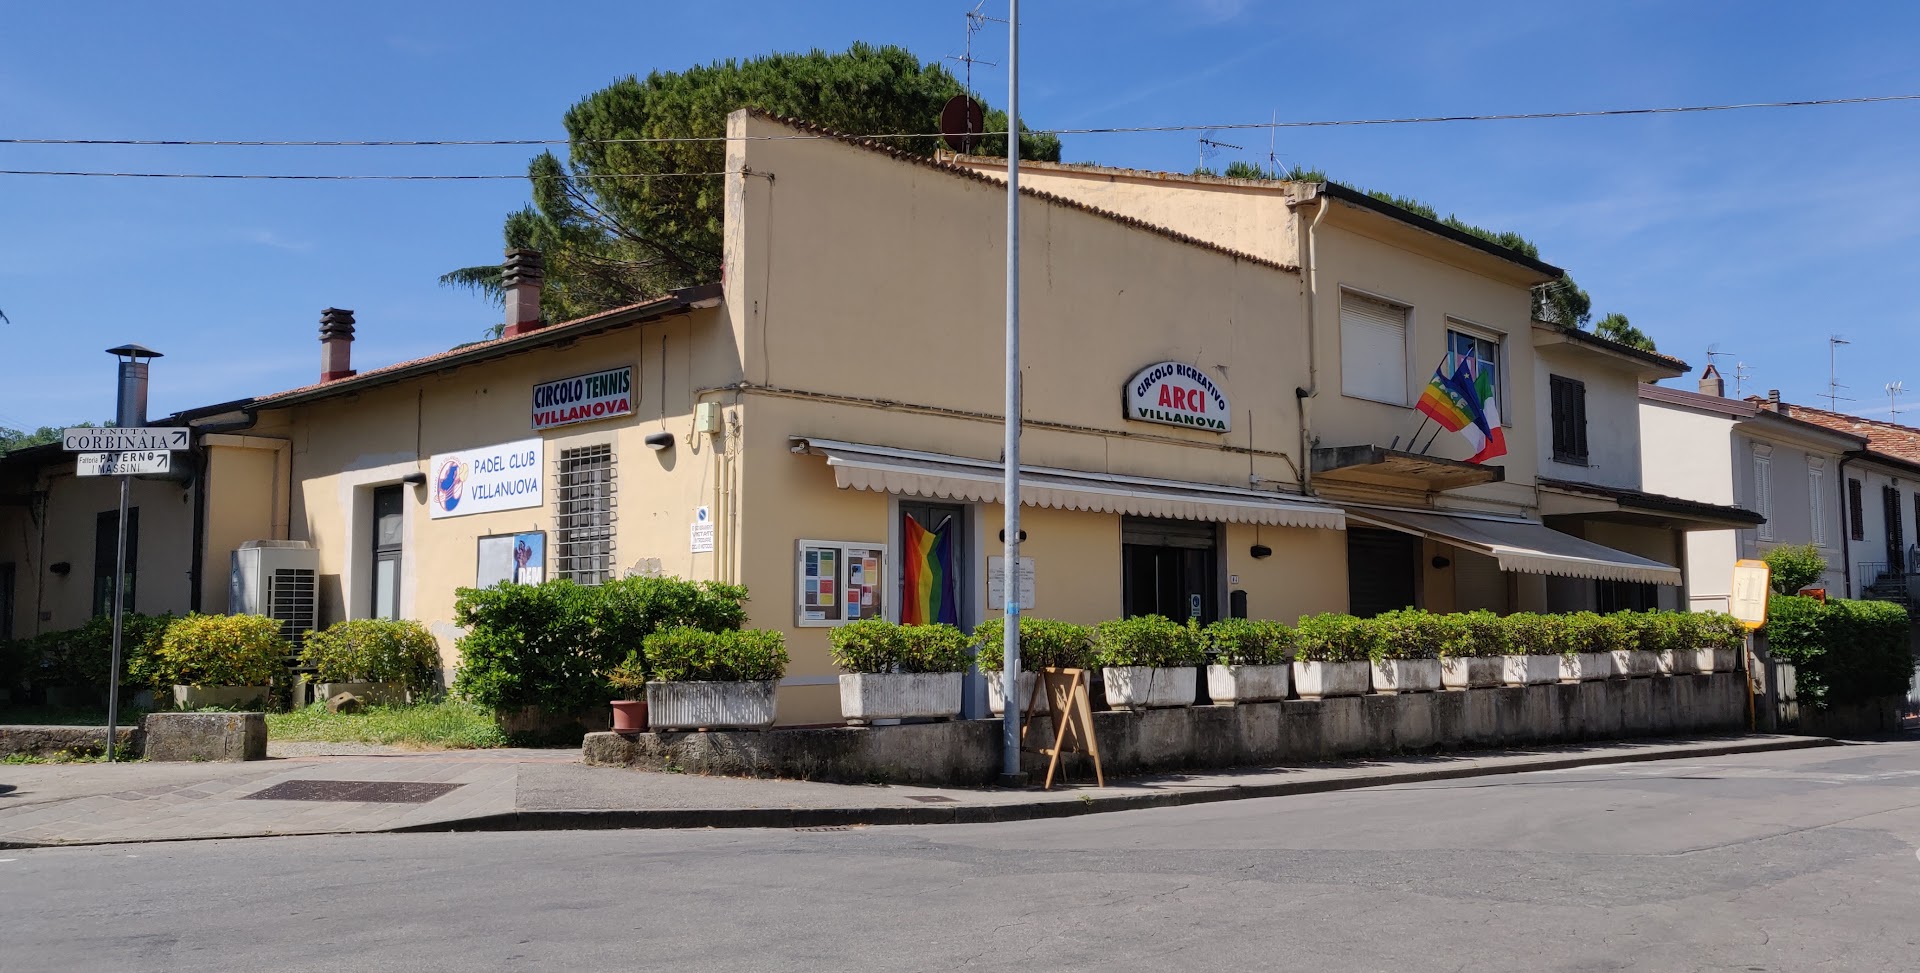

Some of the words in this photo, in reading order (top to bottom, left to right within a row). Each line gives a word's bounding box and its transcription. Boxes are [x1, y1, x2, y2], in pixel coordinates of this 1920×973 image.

[534, 379, 583, 409] CIRCOLO
[585, 369, 630, 400] TENNIS
[1137, 364, 1174, 398] CIRCOLO
[1176, 363, 1226, 411] RICREATIVO
[1158, 383, 1206, 414] ARCI
[533, 398, 630, 426] VILLANOVA
[1137, 407, 1227, 430] VILLANOVA
[66, 436, 168, 449] CORBINAIA
[79, 456, 99, 464] Fattoria
[98, 463, 140, 474] MASSINI
[474, 455, 506, 475] PADEL
[509, 450, 536, 469] CLUB
[471, 477, 539, 501] VILLANUOVA
